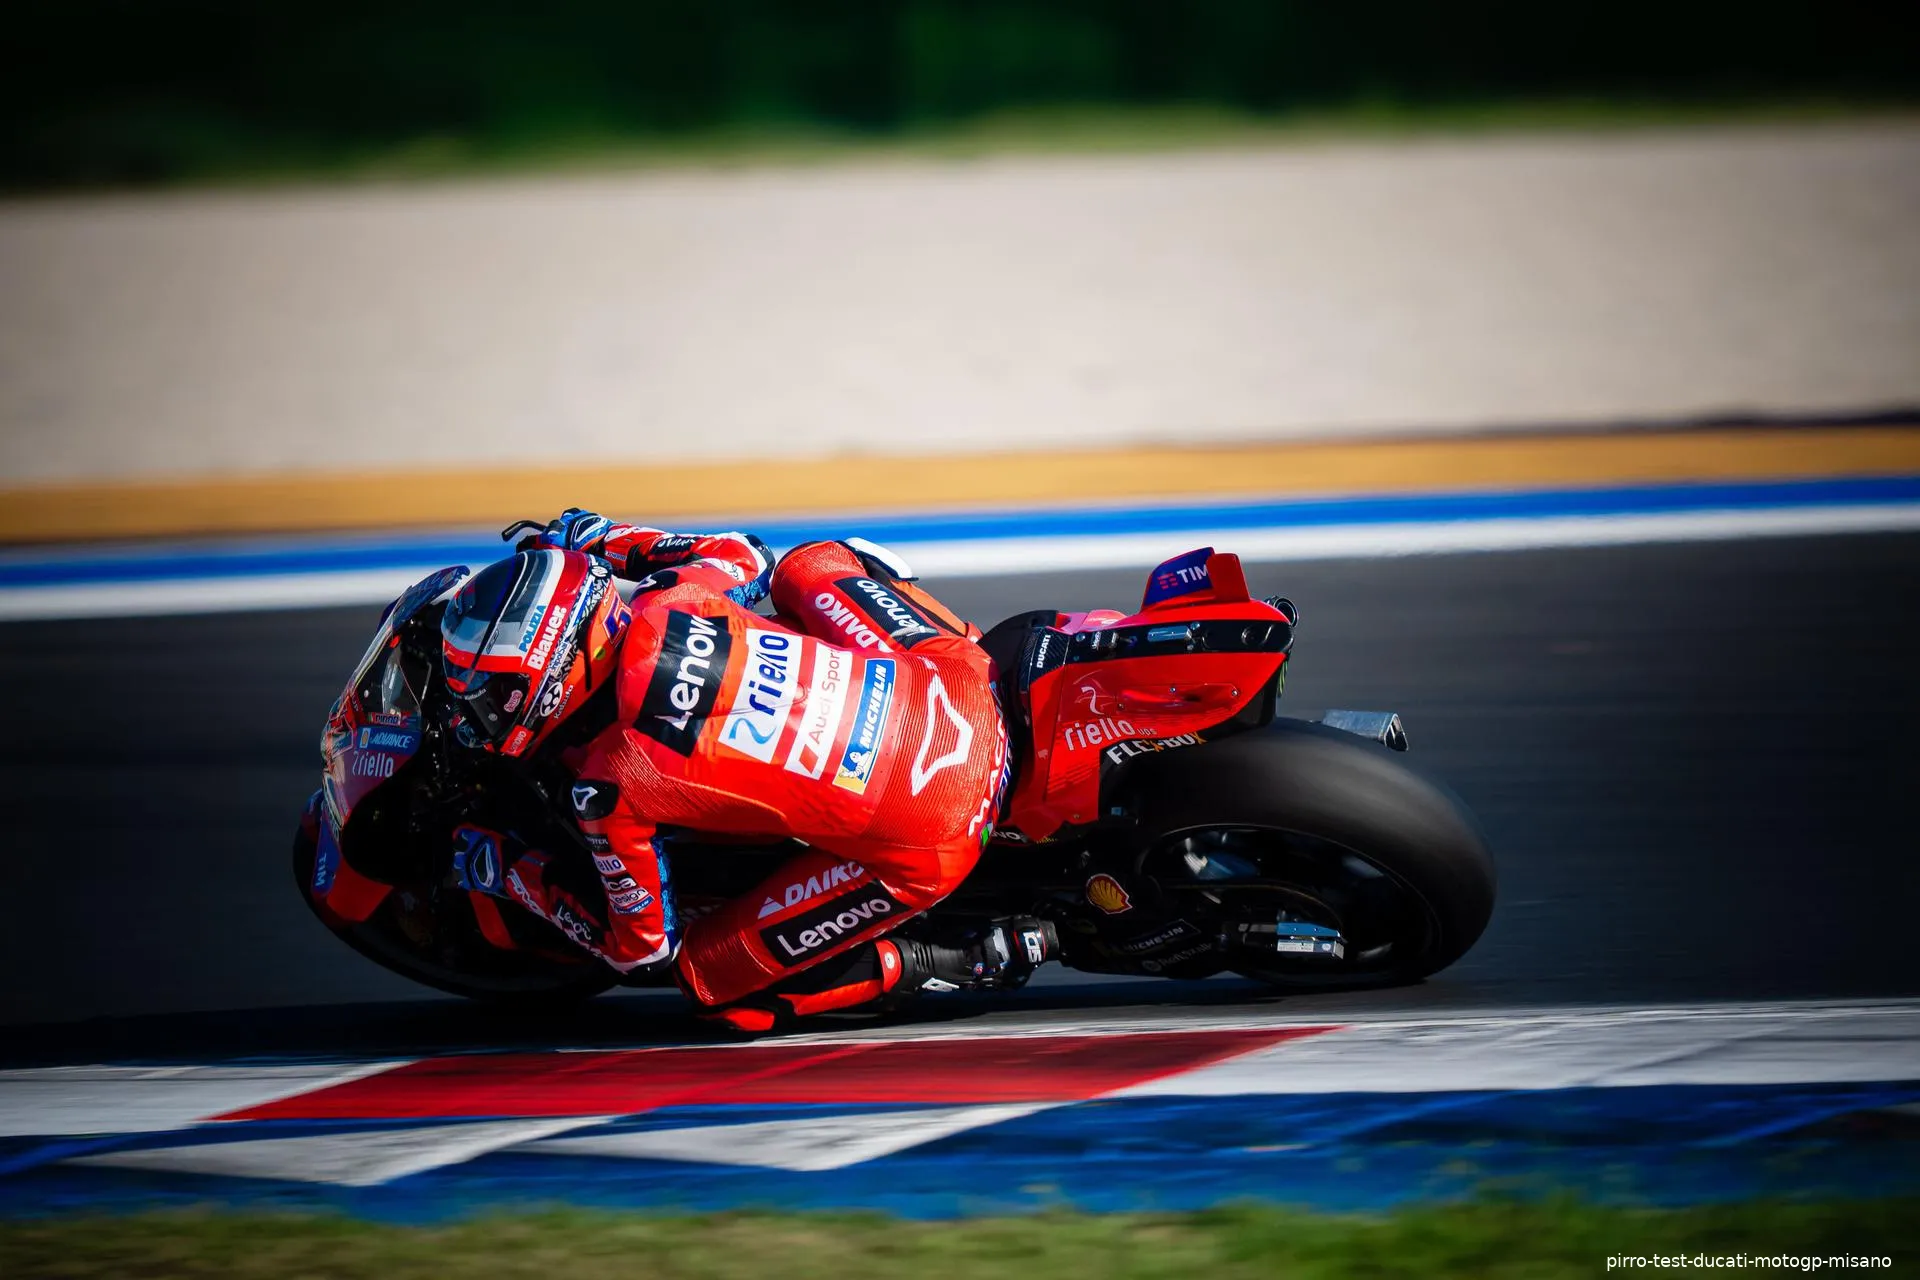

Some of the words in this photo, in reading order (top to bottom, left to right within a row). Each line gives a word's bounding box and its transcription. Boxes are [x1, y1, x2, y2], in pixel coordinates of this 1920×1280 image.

[1177, 563, 1208, 585] TIM
[518, 604, 547, 653] POLIZIA
[814, 592, 881, 649] DAIKO
[1036, 634, 1051, 669] DUCATI
[654, 614, 718, 731] Lenov
[748, 634, 789, 716] riello
[808, 696, 834, 744] Audi
[821, 649, 841, 693] Spor
[859, 663, 887, 749] MICHELIN
[370, 732, 413, 748] ADVANCE
[1065, 717, 1136, 751] riello
[358, 752, 394, 778] riello
[314, 852, 327, 886] TIM
[598, 859, 621, 871] ello
[613, 889, 646, 904] esign
[776, 898, 892, 957] Lenovo
